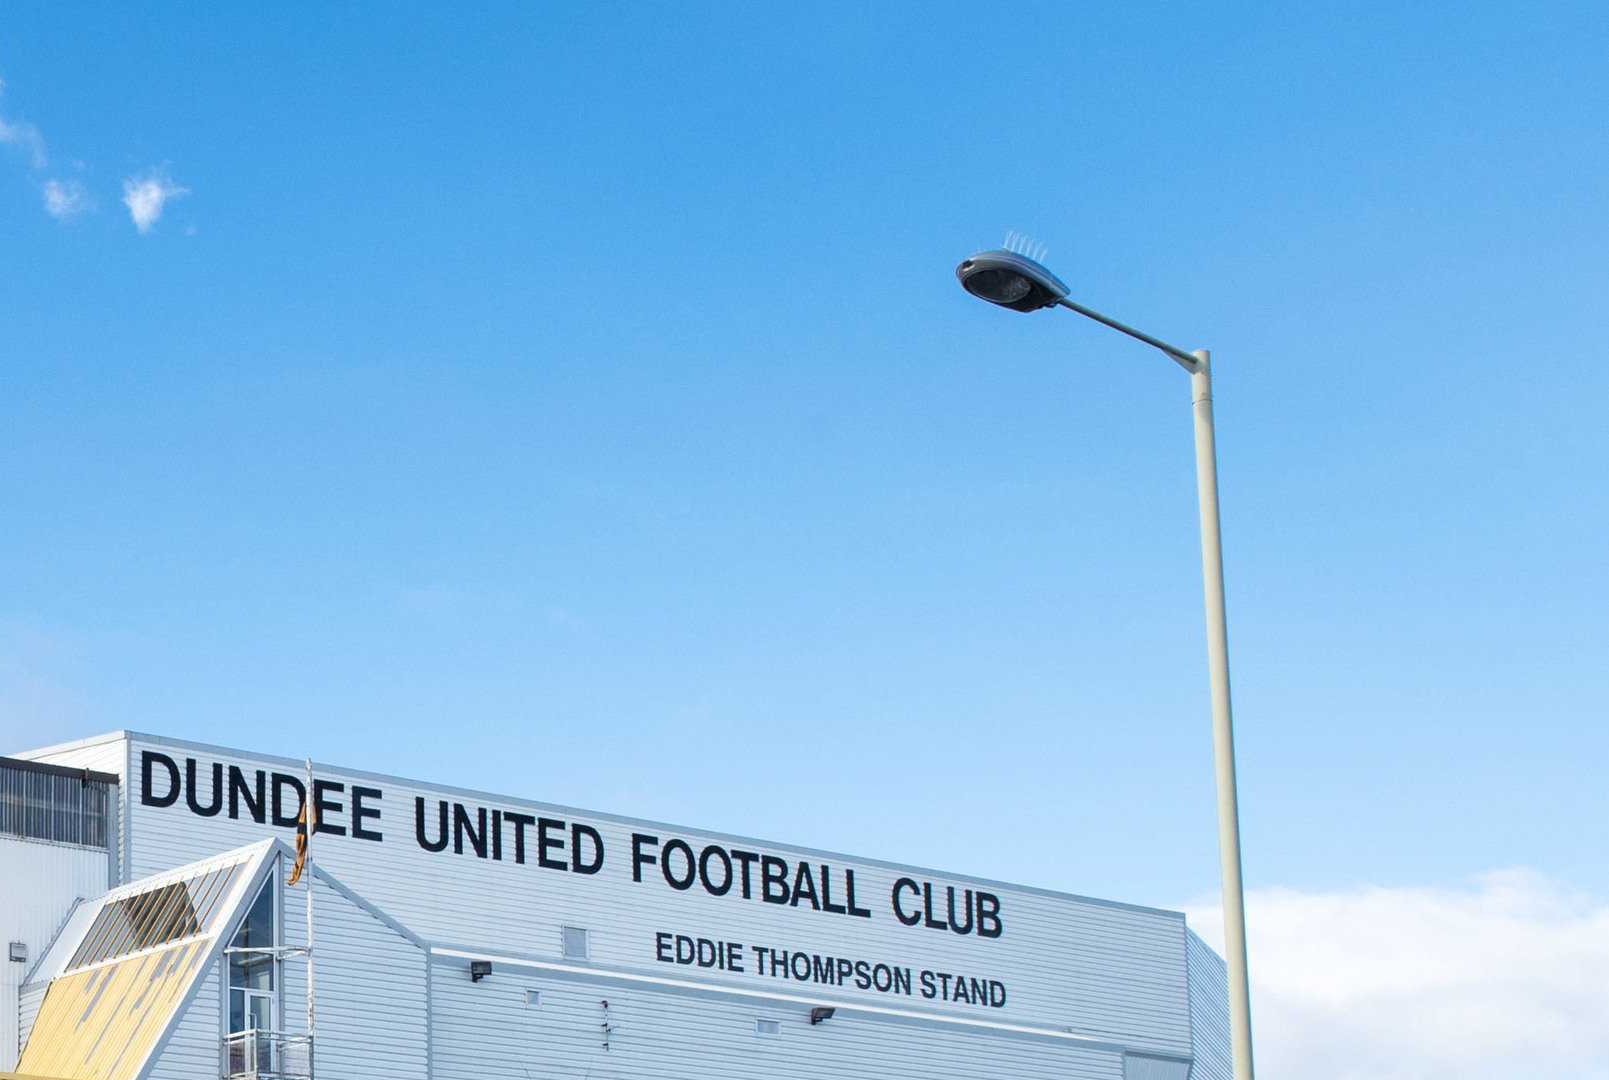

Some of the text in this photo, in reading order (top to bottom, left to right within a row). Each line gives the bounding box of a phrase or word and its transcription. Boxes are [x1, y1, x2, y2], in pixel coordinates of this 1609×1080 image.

[141, 750, 1003, 939] DUNDEE UNITED FOOTBALL CLUB
[655, 931, 1006, 1008] EDDIE THOMPSON STAND
